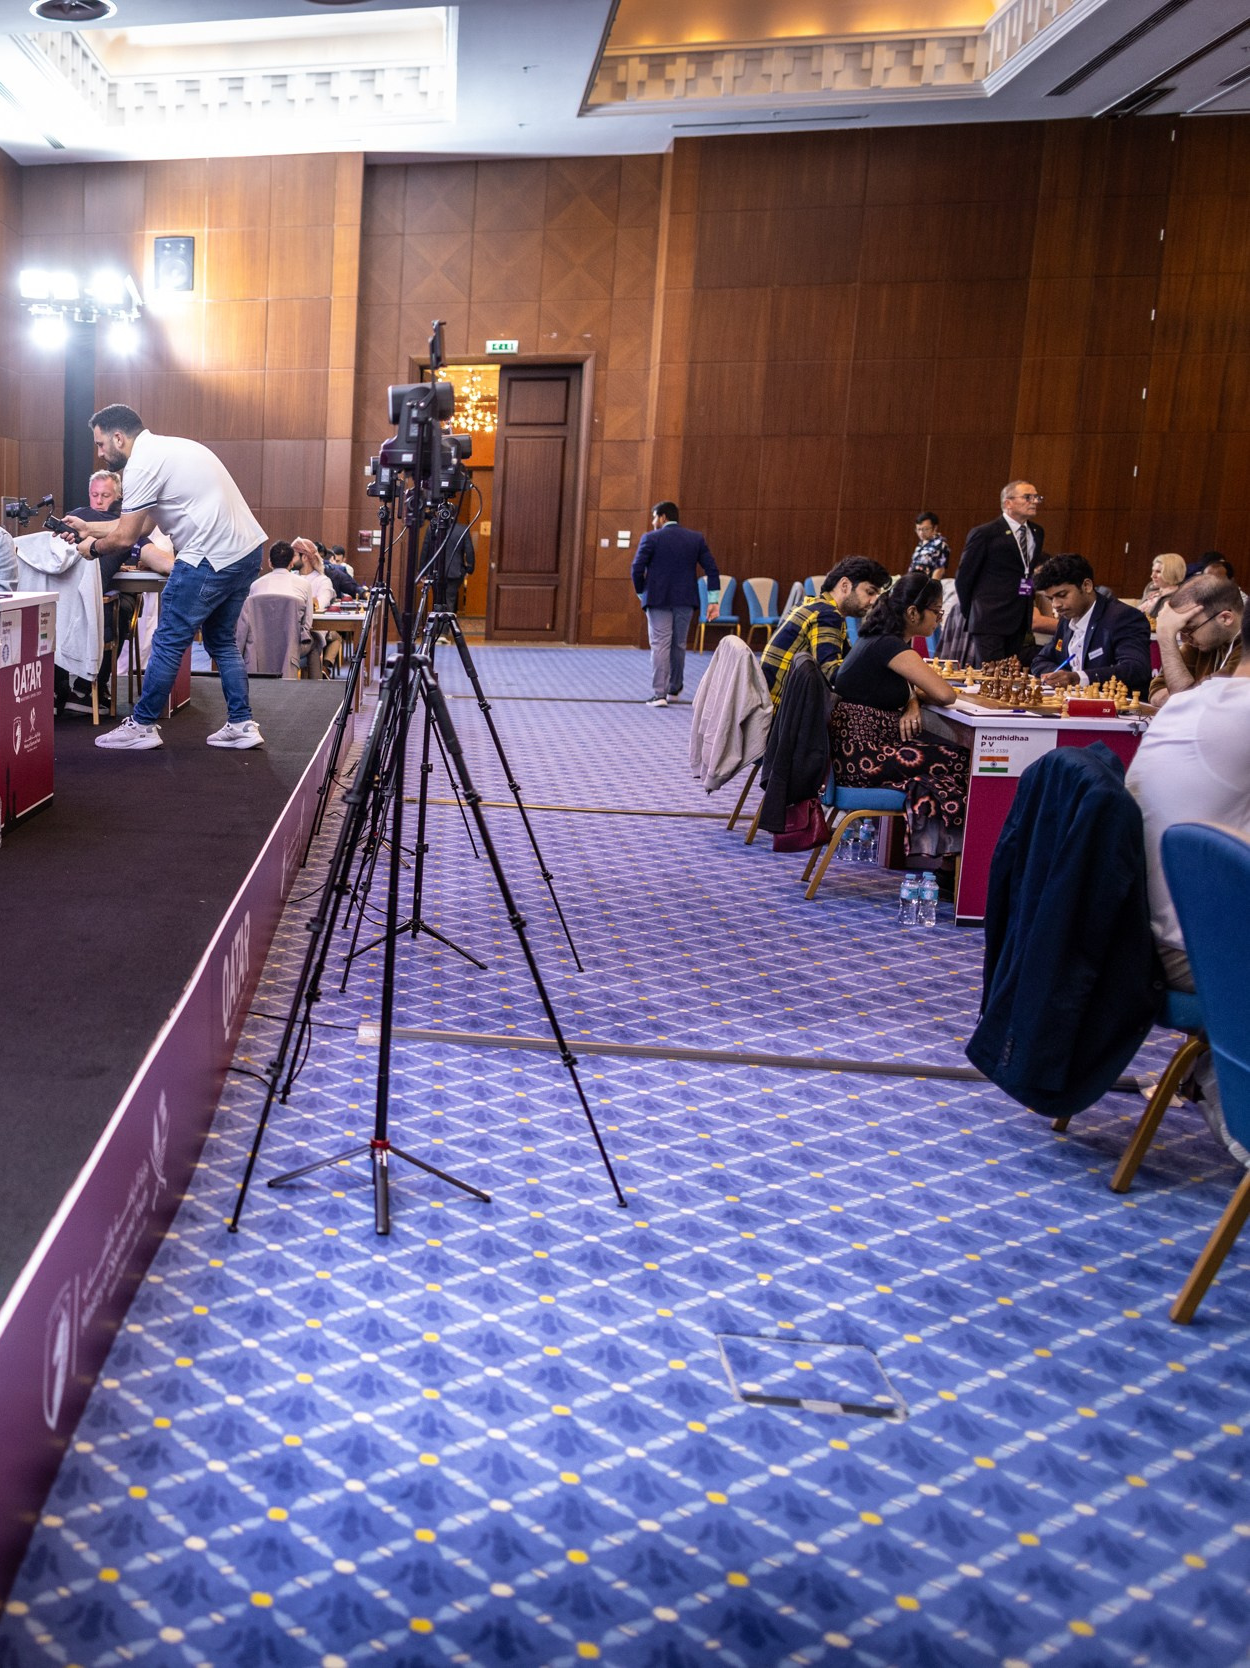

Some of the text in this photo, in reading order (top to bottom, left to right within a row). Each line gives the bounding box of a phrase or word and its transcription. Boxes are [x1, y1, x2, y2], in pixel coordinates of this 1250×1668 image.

[13, 660, 42, 703] QATAR
[981, 734, 1029, 742] Nandhidhaa
[222, 909, 250, 1042] QATAR
